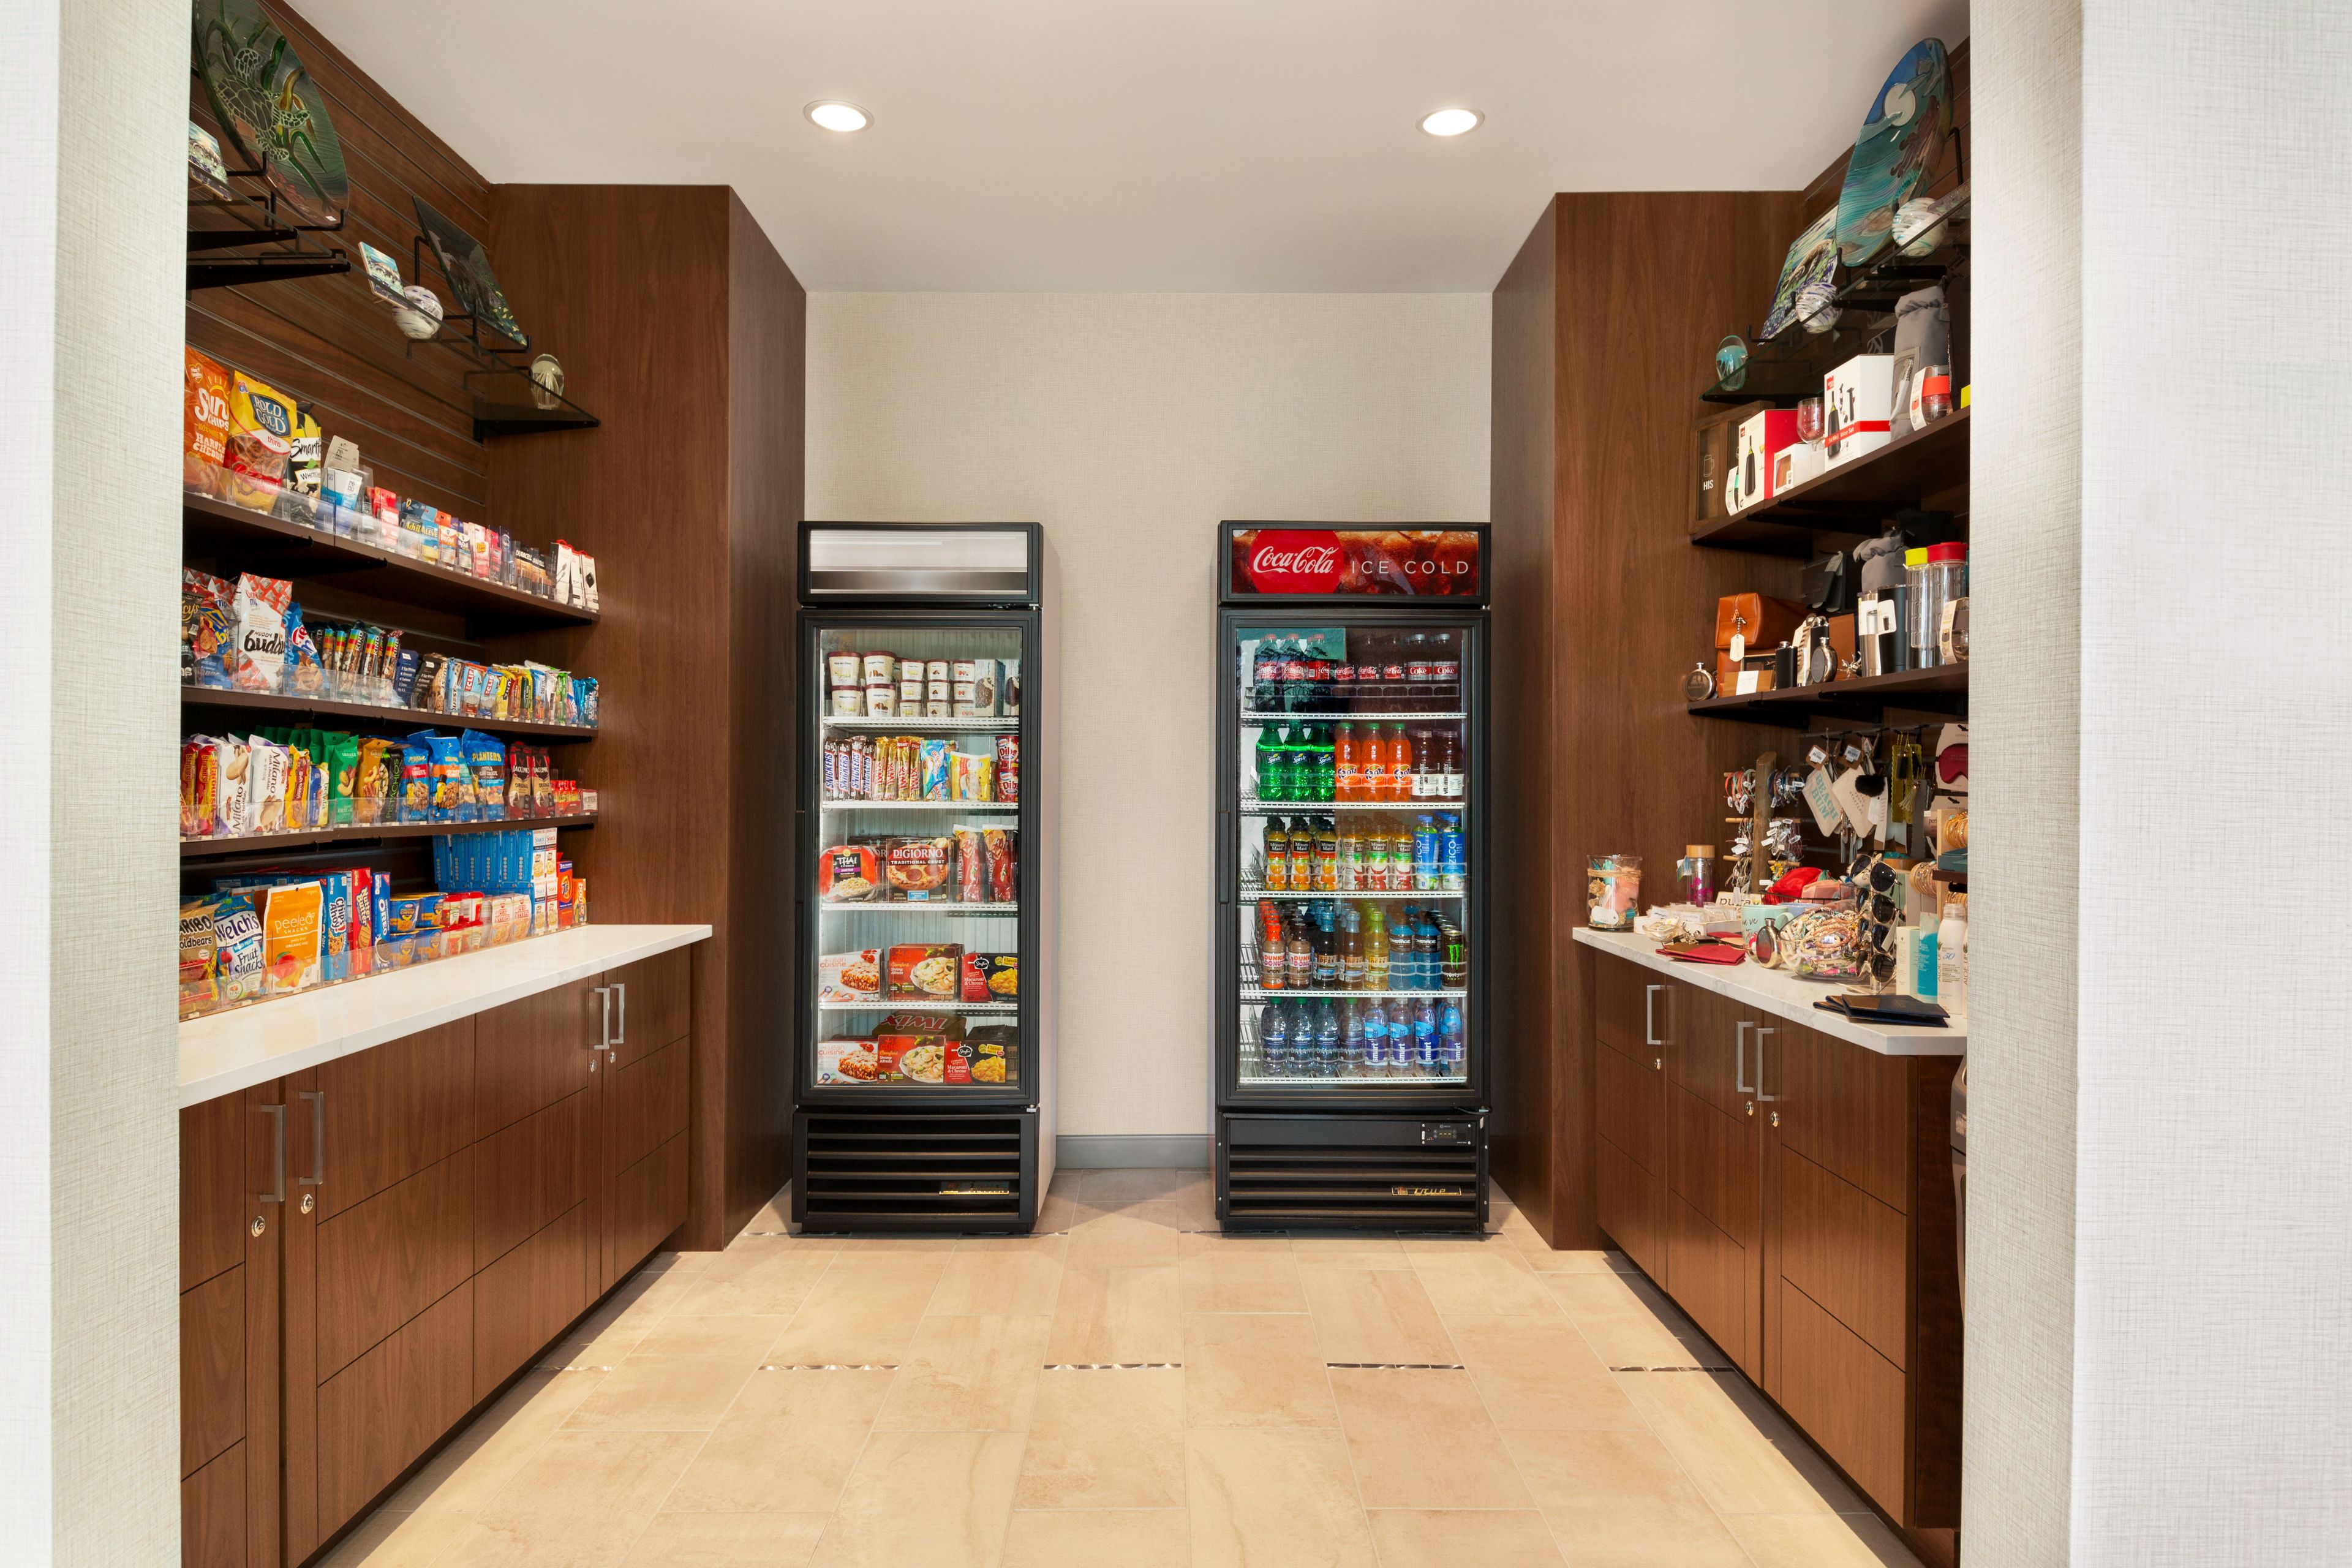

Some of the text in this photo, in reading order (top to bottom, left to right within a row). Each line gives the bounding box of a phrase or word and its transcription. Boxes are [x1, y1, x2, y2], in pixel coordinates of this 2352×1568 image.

[195, 388, 229, 421] Sun
[253, 395, 282, 417] ROLD
[208, 413, 229, 432] CHIPS
[255, 408, 287, 433] GOLD
[268, 436, 281, 447] thins
[1703, 480, 1714, 490] HIS
[405, 522, 421, 533] Advil
[421, 527, 438, 538] ALEVE
[516, 550, 532, 560] DURACELL
[1253, 546, 1339, 574] Coca-Cola
[1351, 560, 1469, 574] ICE COLD
[472, 752, 502, 762] PLANTERS
[271, 749, 281, 793] Milano
[840, 755, 848, 790] SNICKERS
[1338, 767, 1357, 779] Fanta
[1365, 768, 1384, 779] Fanta
[386, 759, 399, 818] PISTACHIOS
[1815, 774, 1838, 820] BEACH
[232, 786, 243, 832] Milano
[1811, 786, 1830, 820] BUM
[336, 898, 345, 925] Chips
[356, 894, 367, 927] Butter
[361, 887, 370, 921] Nutter
[214, 914, 259, 942] Welch's
[274, 913, 314, 934] peeled
[237, 949, 258, 965] Fruit
